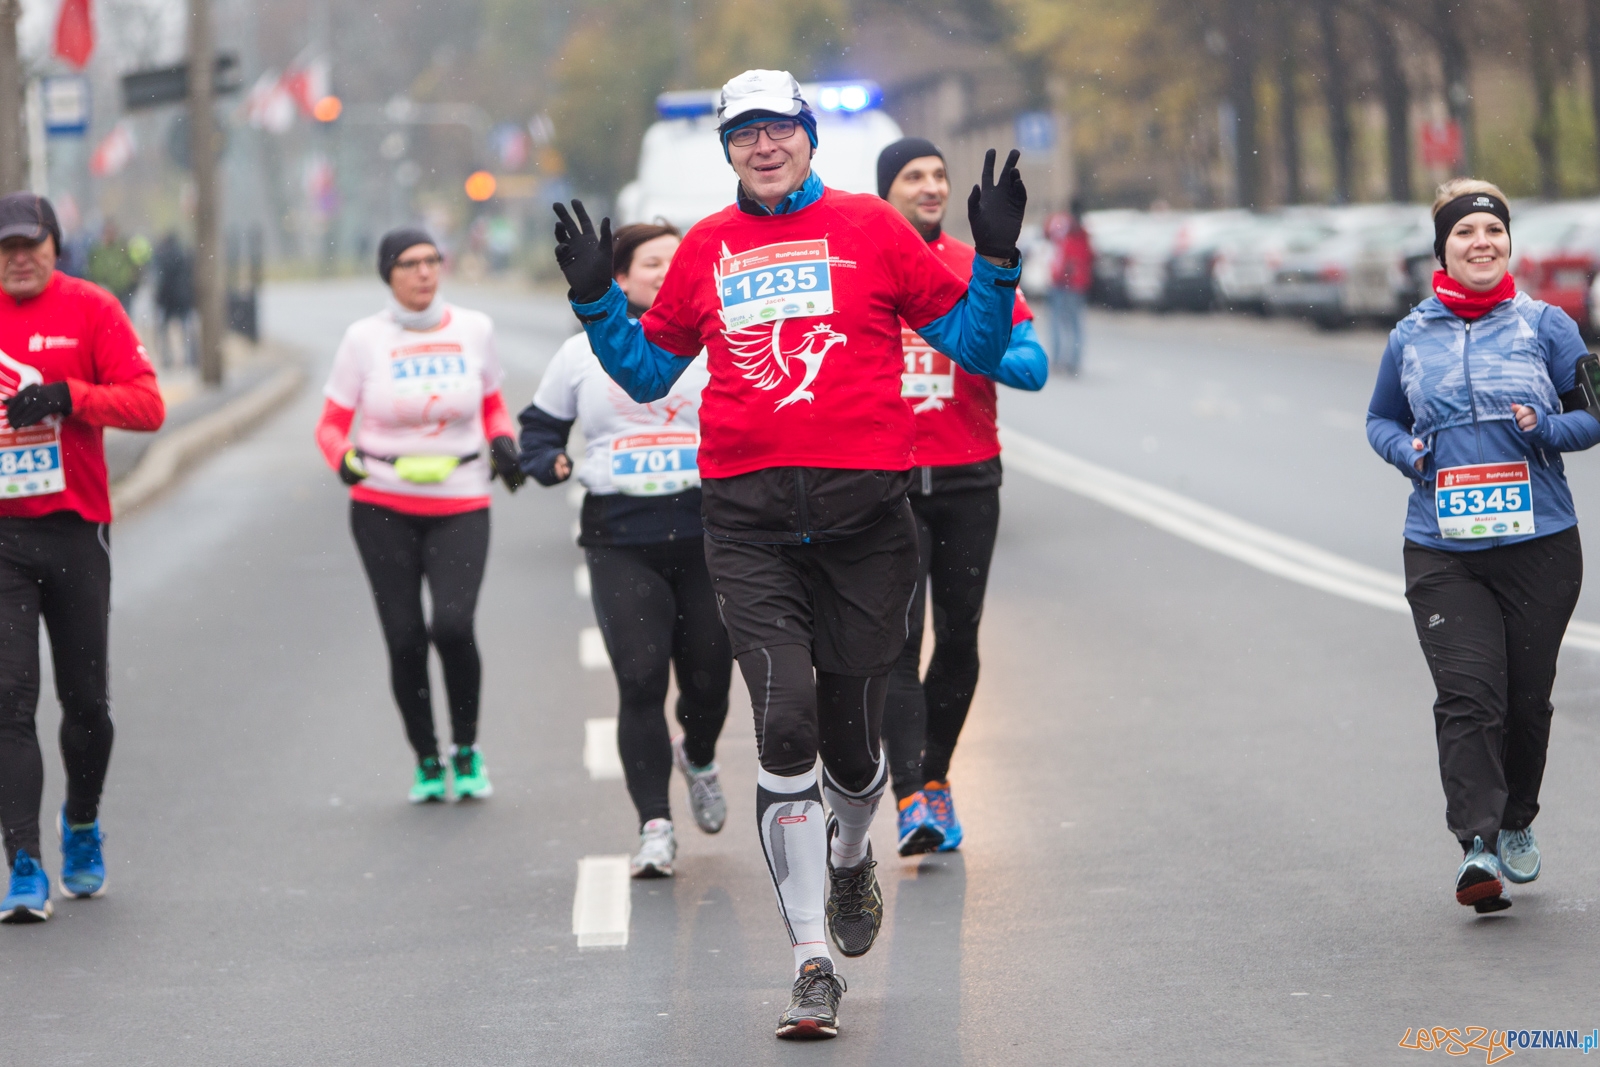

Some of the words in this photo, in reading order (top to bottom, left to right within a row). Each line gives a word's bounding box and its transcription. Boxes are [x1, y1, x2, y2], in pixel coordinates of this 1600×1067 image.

[775, 249, 820, 259] RunPoland.org
[724, 287, 732, 296] E
[736, 266, 818, 300] 1235
[765, 297, 786, 306] Jacek
[403, 356, 460, 377] 1713
[0, 448, 53, 475] 843
[630, 449, 680, 473] 701
[1486, 471, 1523, 479] RunPoland.org
[1449, 487, 1522, 515] 5345
